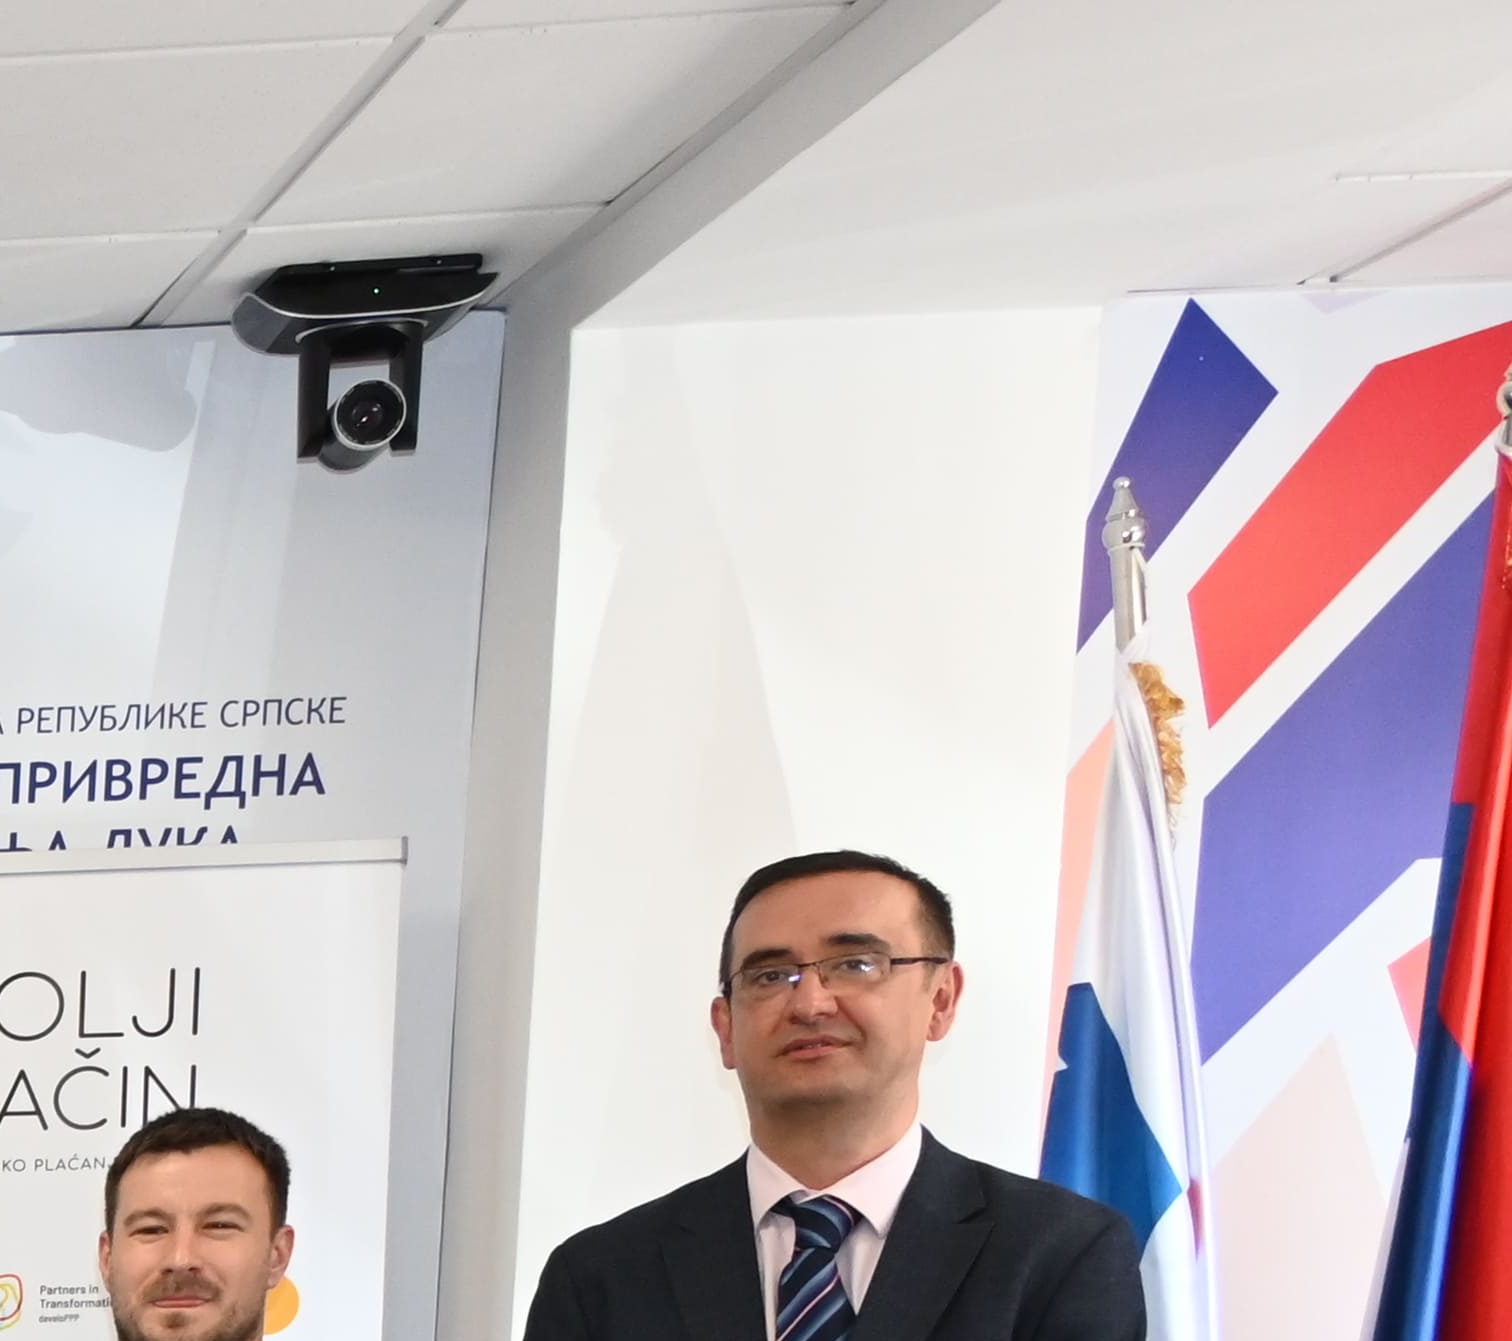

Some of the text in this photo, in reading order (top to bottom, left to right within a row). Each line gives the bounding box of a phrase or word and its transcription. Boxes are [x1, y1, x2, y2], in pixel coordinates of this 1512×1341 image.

[16, 702, 208, 734] РЕПУБЛИКЕ
[220, 697, 346, 728] СРПСКЕ
[34, 1153, 111, 1172] PLAĆAN
[40, 1283, 99, 1295] Partners in
[40, 1298, 110, 1309] Transformati
